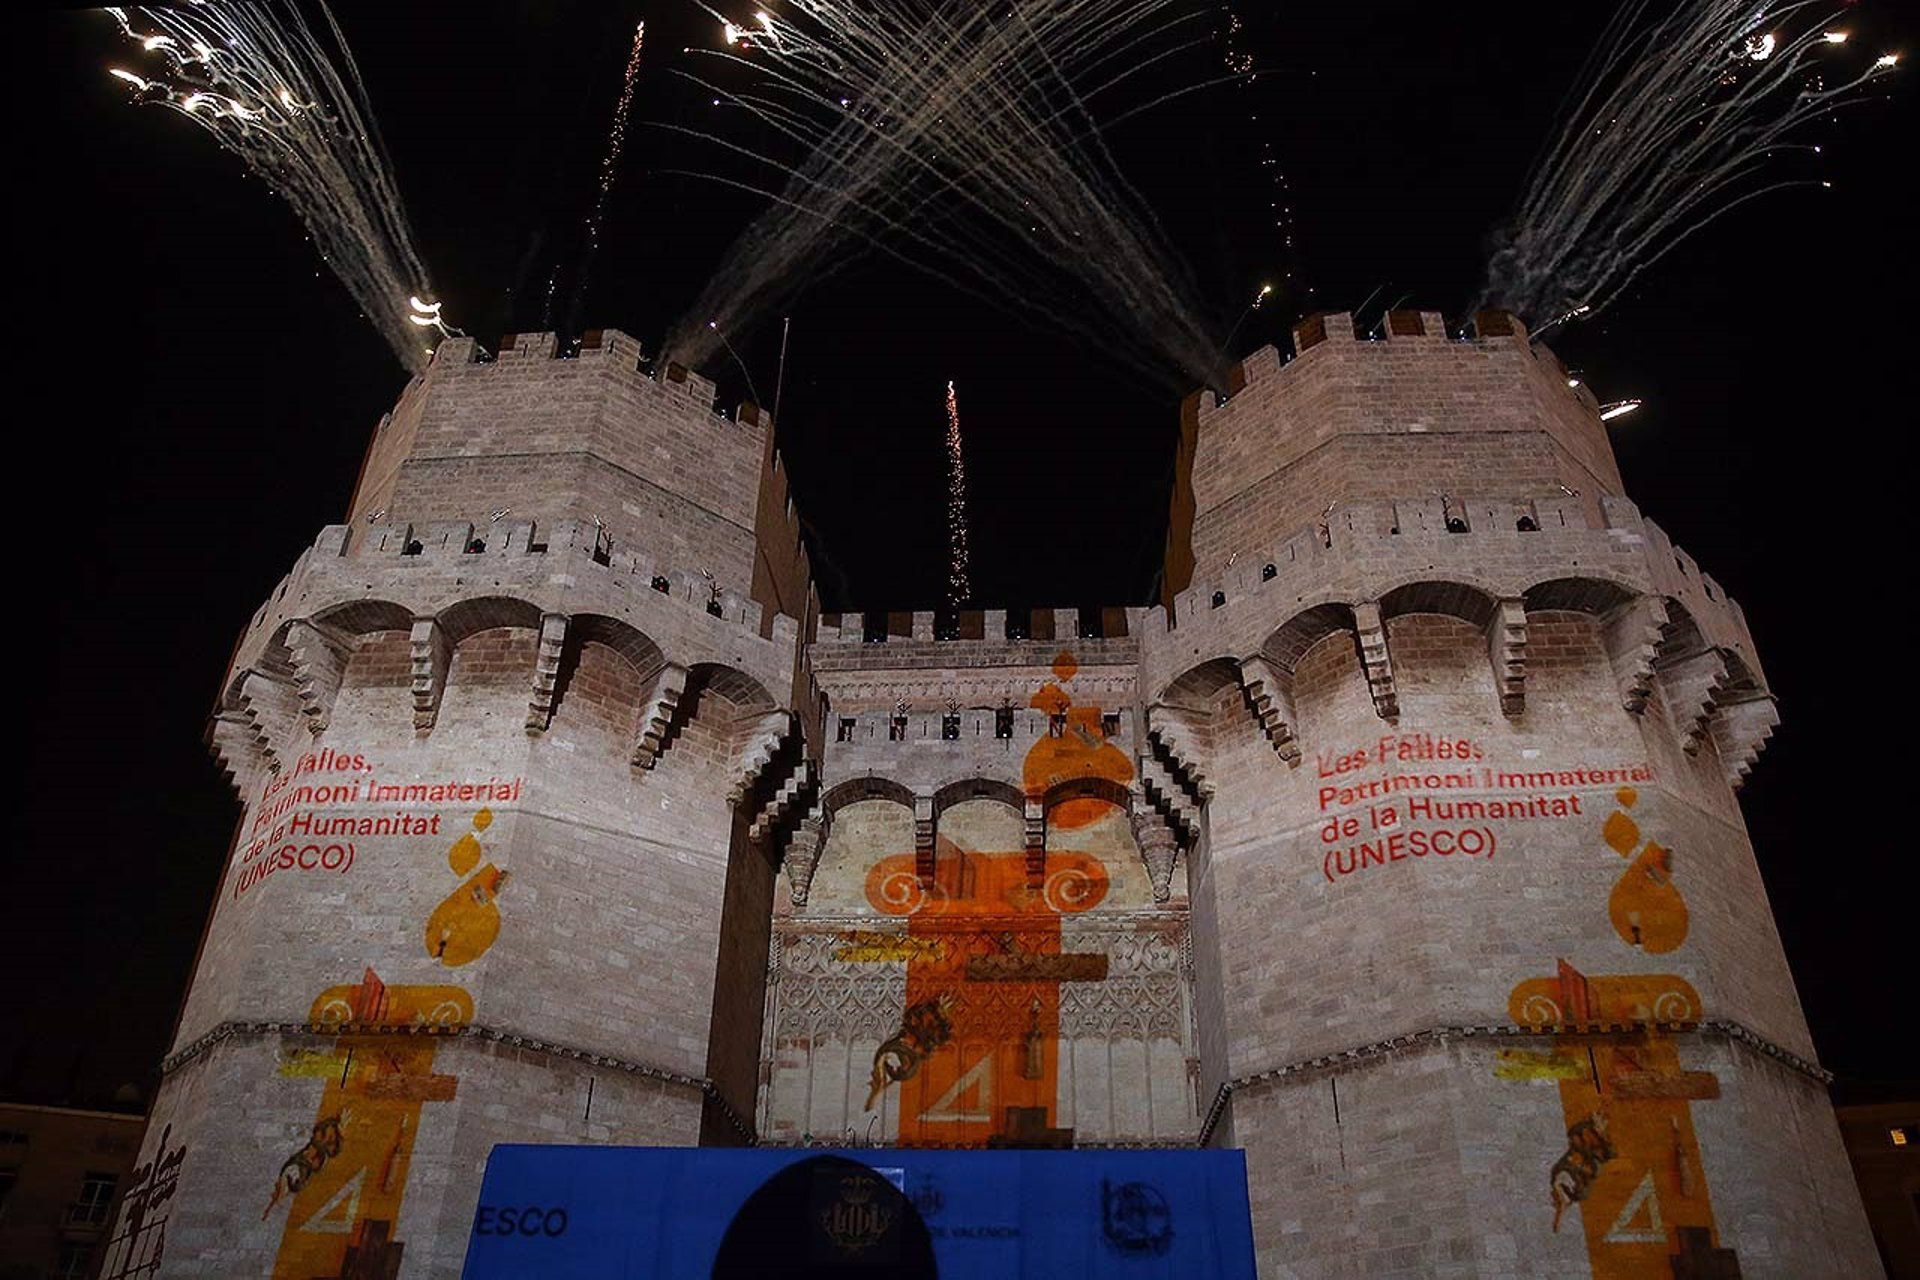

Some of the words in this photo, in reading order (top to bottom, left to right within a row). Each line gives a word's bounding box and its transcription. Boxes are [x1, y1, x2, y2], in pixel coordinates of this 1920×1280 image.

[1317, 750, 1368, 779] Les
[1318, 768, 1475, 812] Patrimoni
[1481, 763, 1653, 789] Immaterial
[366, 777, 521, 802] Immaterial
[242, 838, 266, 864] de
[268, 824, 285, 847] la
[290, 811, 442, 836] Humanitat
[1321, 816, 1360, 844] de
[1369, 803, 1398, 831] la
[1408, 795, 1583, 821] Humanitat
[234, 843, 355, 901] (UNESCO)
[1324, 826, 1496, 883] (UNESCO)
[477, 1205, 568, 1238] ESCO
